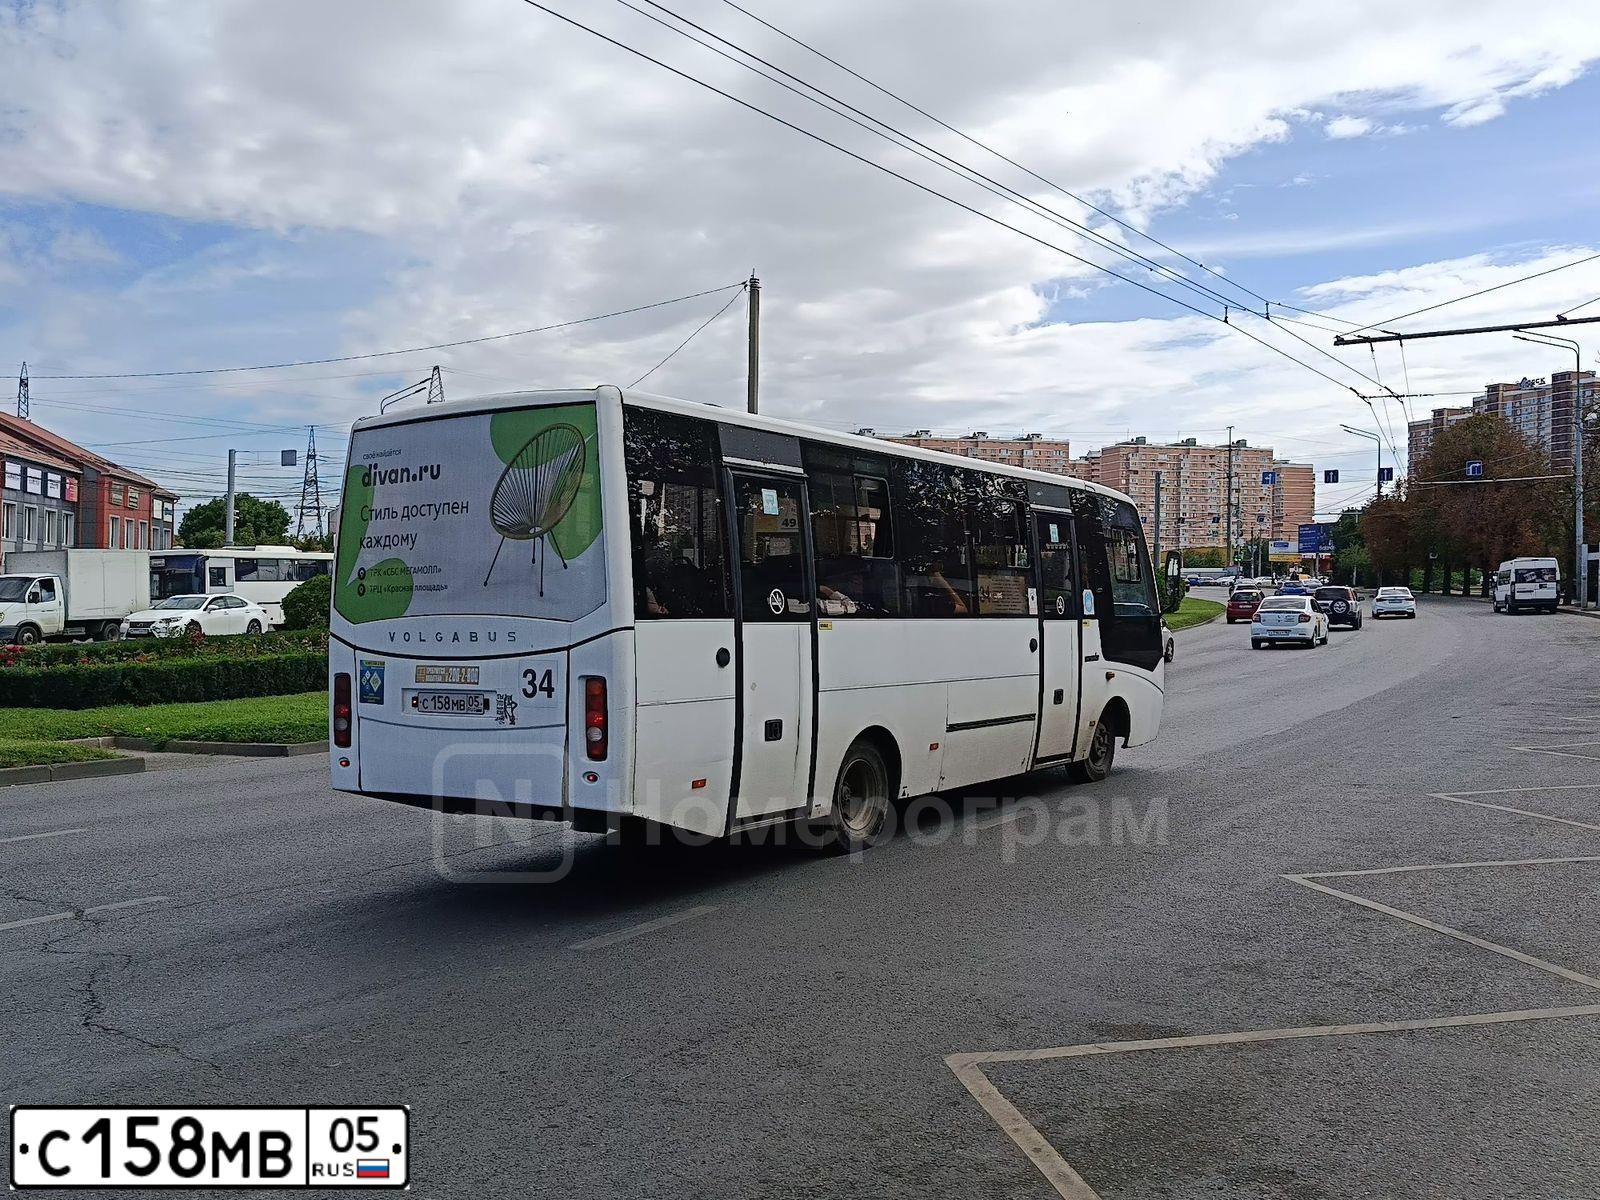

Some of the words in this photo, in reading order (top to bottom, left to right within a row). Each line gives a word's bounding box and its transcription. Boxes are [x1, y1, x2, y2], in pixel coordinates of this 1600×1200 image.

[361, 463, 441, 487] divan.ru
[360, 504, 398, 522] Стиль
[400, 500, 469, 522] доступен
[359, 532, 418, 551] каждому
[369, 568, 382, 577] ТРК
[400, 565, 442, 576] МЕГАМОЛЛ»
[414, 583, 448, 592] площадь»
[388, 631, 516, 642] VOLGABUS
[521, 668, 555, 699] 34
[468, 696, 479, 707] 05
